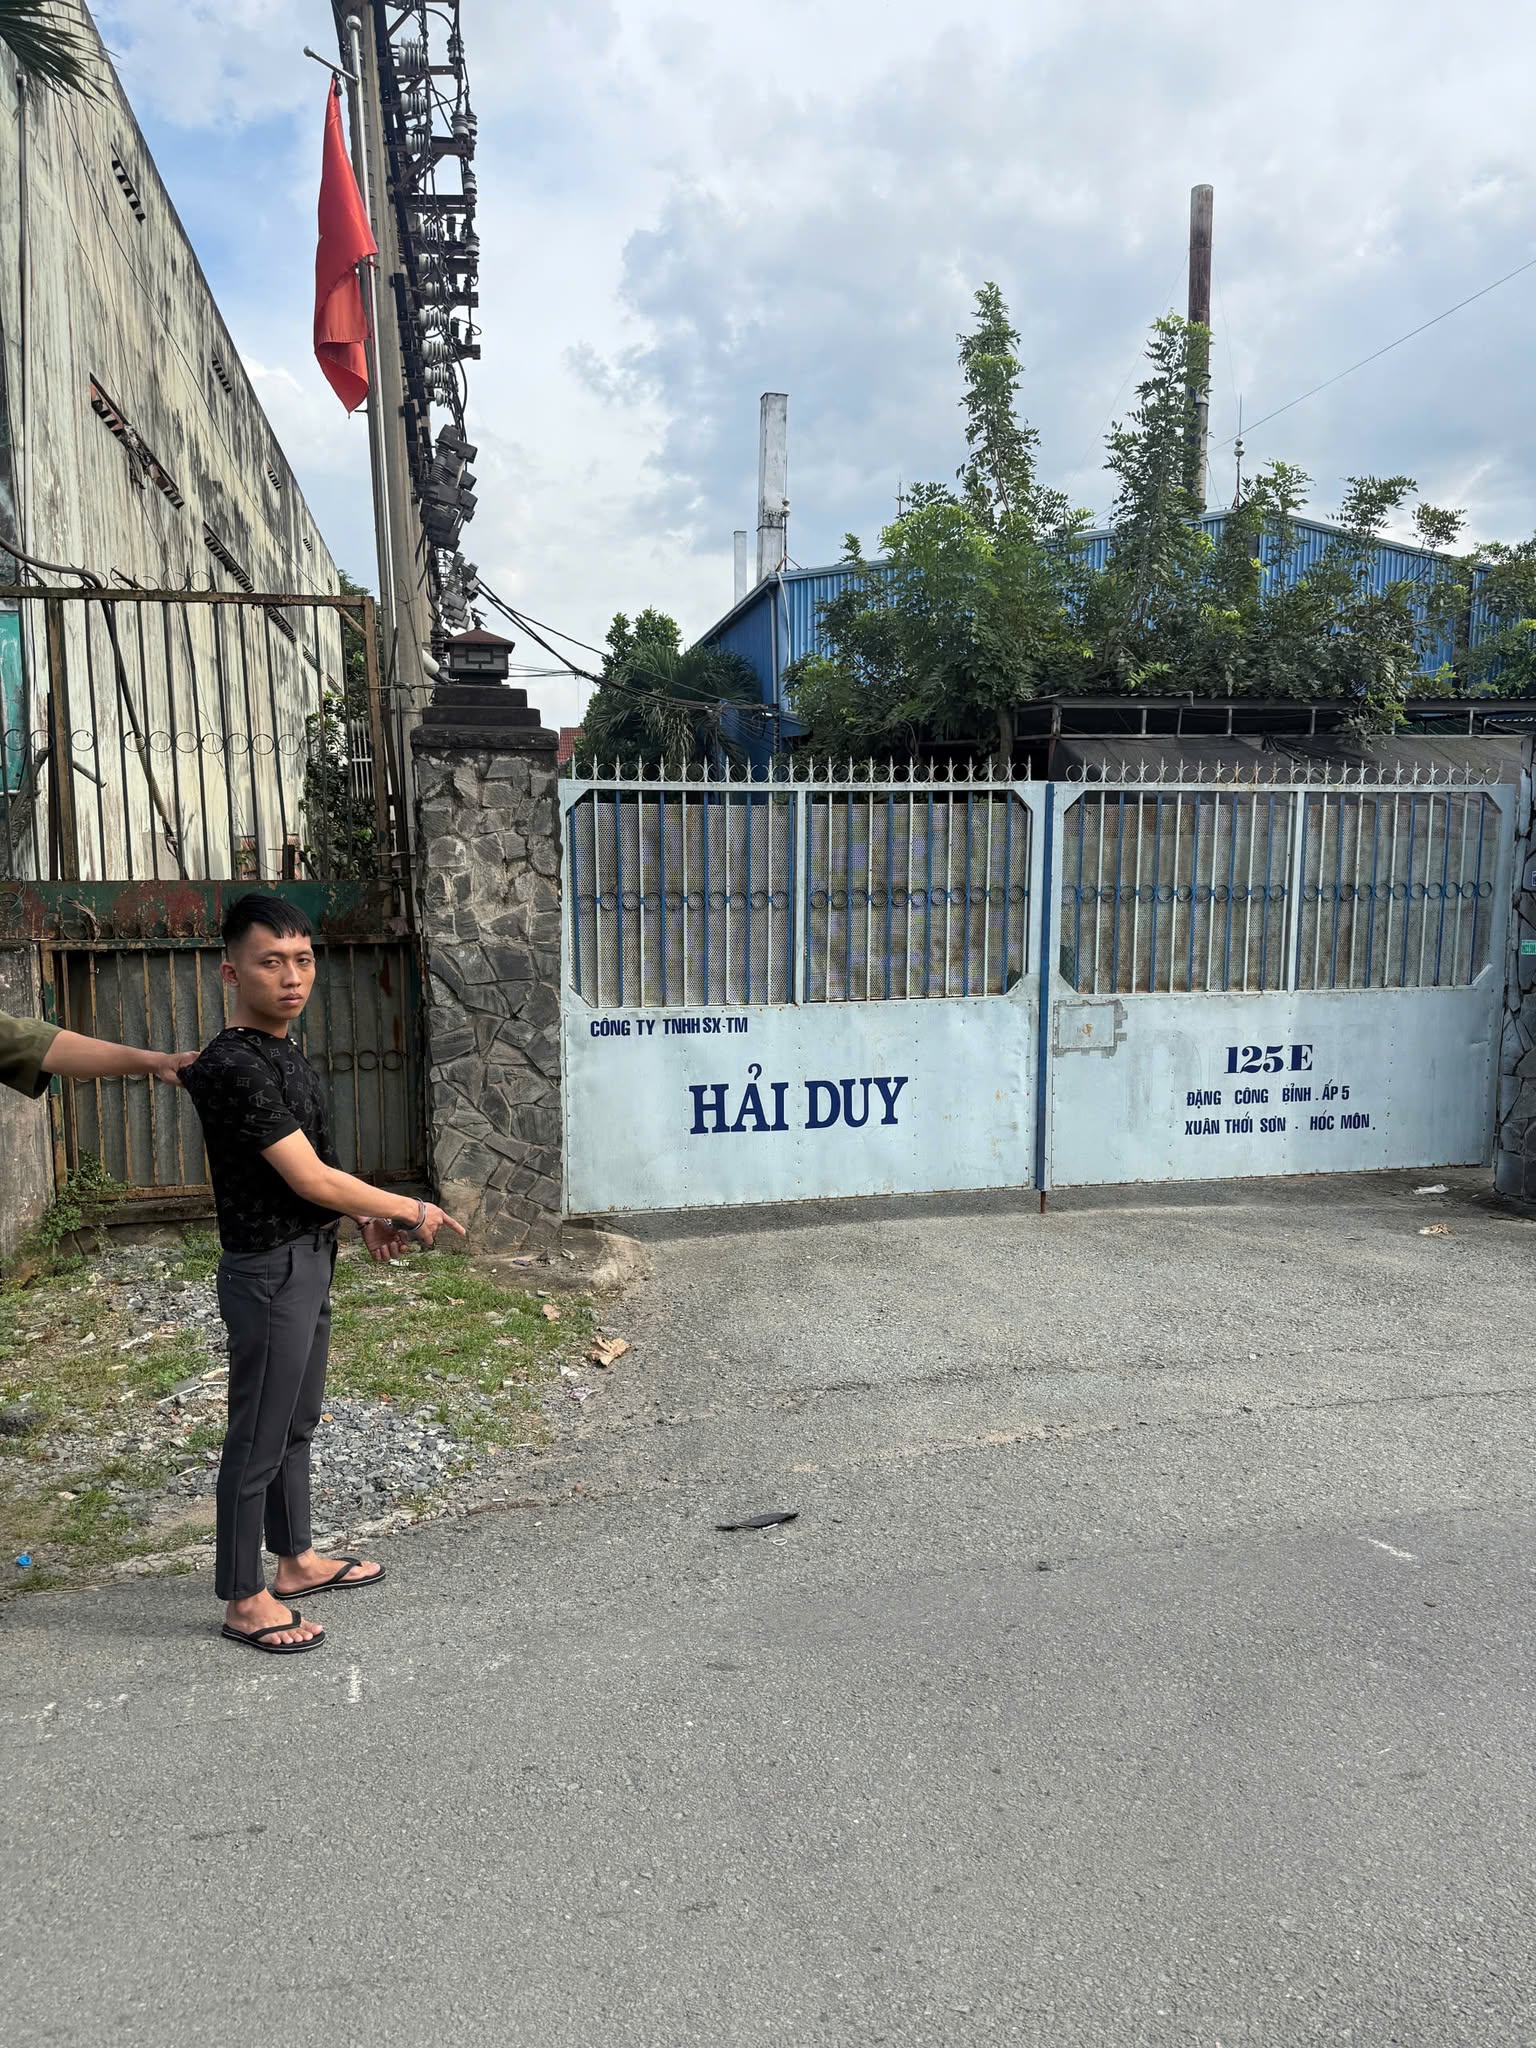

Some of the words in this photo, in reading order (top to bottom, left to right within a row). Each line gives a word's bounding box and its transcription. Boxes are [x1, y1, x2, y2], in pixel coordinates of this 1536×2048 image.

[590, 1018, 631, 1037] CÔNG
[636, 1019, 655, 1035] TY
[663, 1018, 699, 1034] TNHH
[689, 1063, 789, 1134] HẢI
[804, 1077, 909, 1129] DUY
[1187, 1088, 1222, 1109] ĐẶNG
[1234, 1087, 1269, 1104] CÔNG
[1341, 1085, 1350, 1100] 5
[1185, 1118, 1220, 1135] XUÂN
[1224, 1111, 1253, 1133] THỚI
[1260, 1115, 1286, 1132] SƠN
[1310, 1109, 1335, 1130] HÓC
